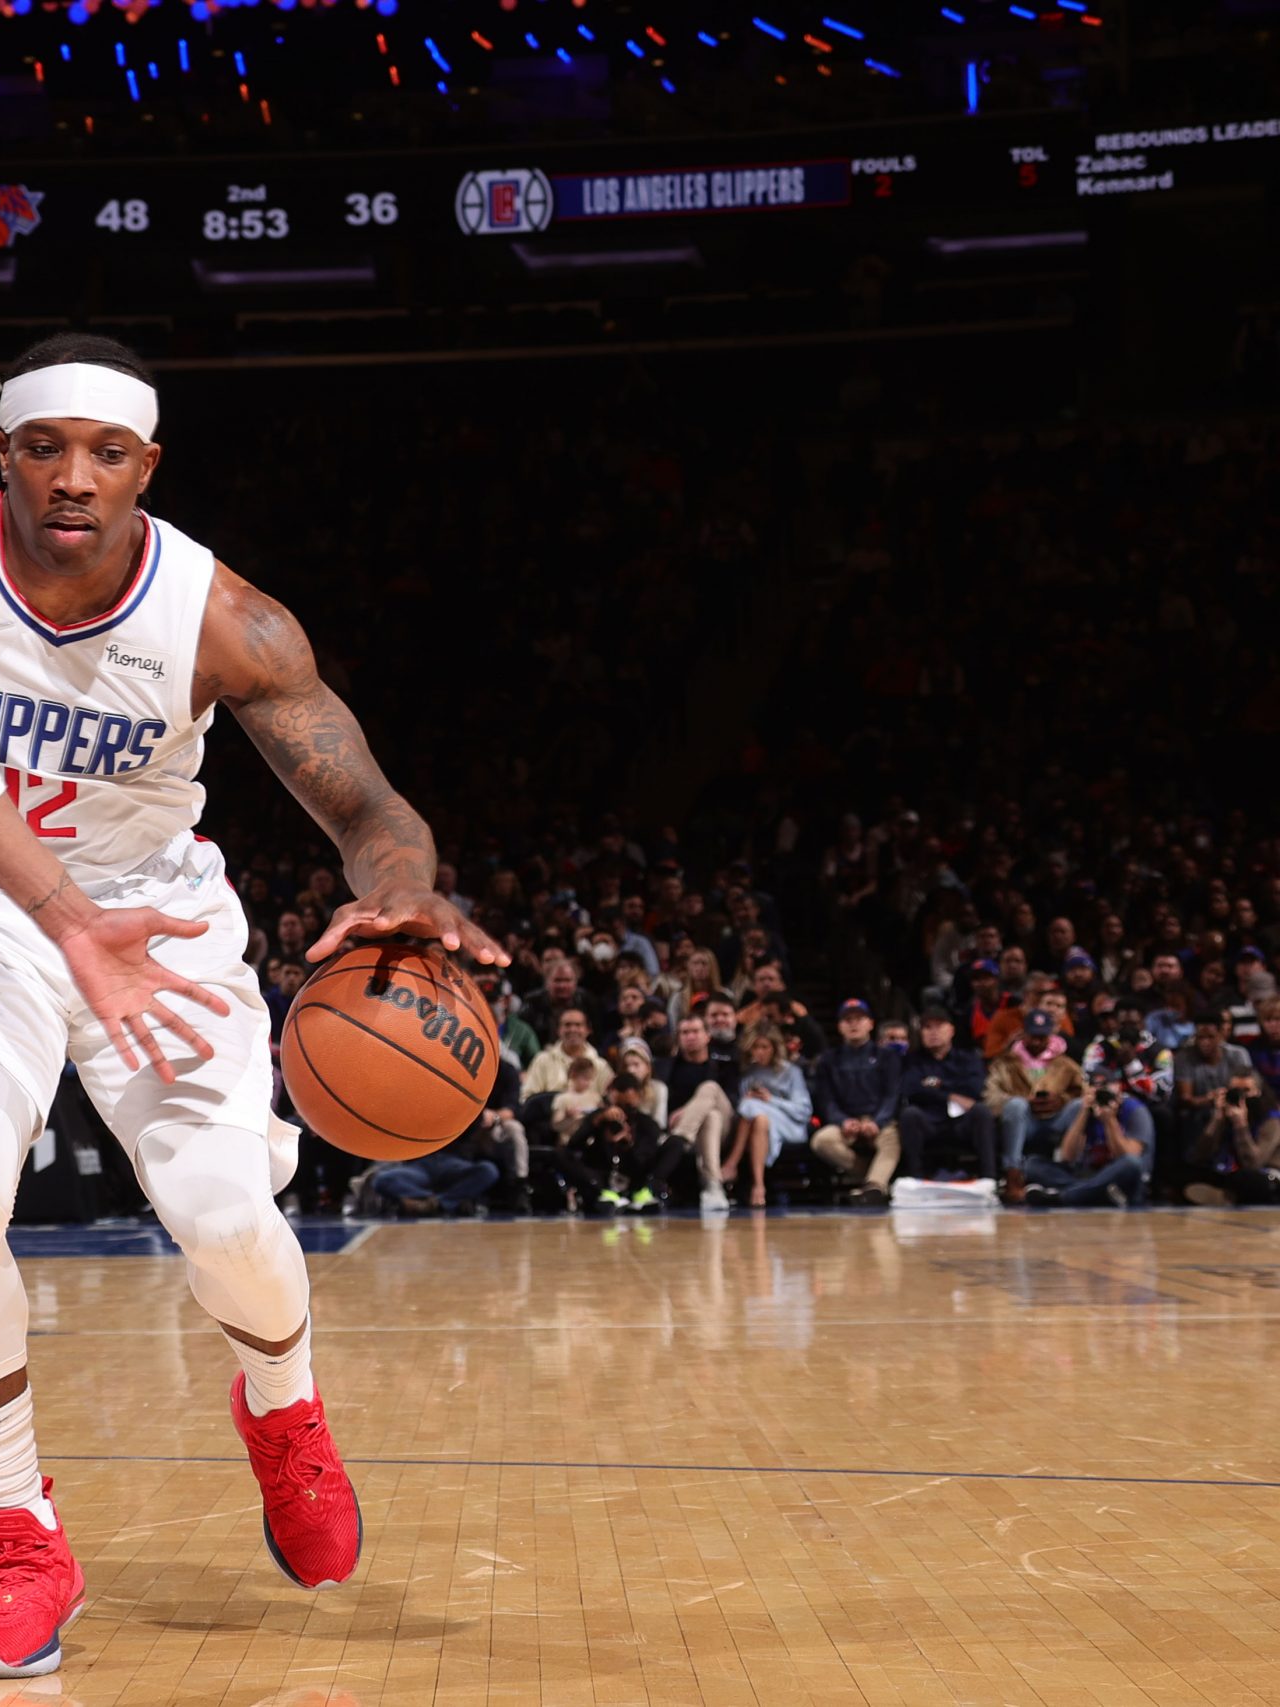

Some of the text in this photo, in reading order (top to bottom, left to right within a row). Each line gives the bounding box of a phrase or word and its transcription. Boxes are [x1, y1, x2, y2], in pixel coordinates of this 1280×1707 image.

[1095, 118, 1280, 152] REBOUNDS LEADE
[851, 156, 917, 175] FOULS
[1010, 147, 1049, 163] TOL
[1076, 155, 1148, 174] Zubac
[872, 176, 894, 198] 2
[1019, 164, 1038, 188] 5
[1076, 171, 1174, 196] Kennard
[226, 184, 267, 203] 2nd
[582, 166, 805, 215] LOS ANGELES CLIPPERS
[94, 199, 150, 232] 48
[344, 191, 399, 226] 36
[202, 208, 290, 241] 8:53
[106, 645, 164, 679] honey
